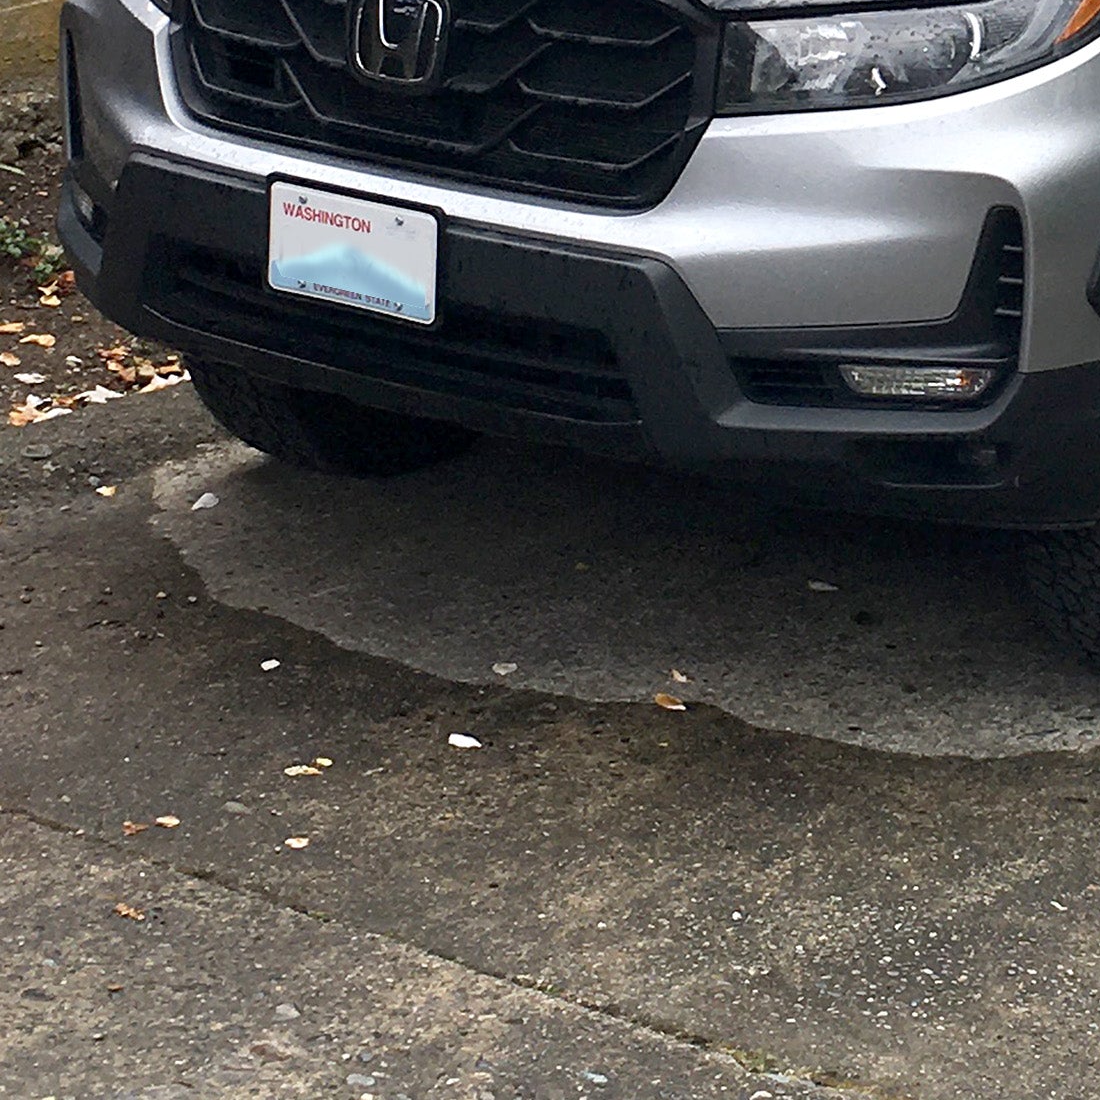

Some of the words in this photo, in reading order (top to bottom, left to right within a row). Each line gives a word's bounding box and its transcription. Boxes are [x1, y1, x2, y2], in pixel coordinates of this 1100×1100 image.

[283, 202, 371, 233] WASHINGTON
[313, 283, 362, 300] EVERGREEN
[366, 295, 390, 307] STATE
